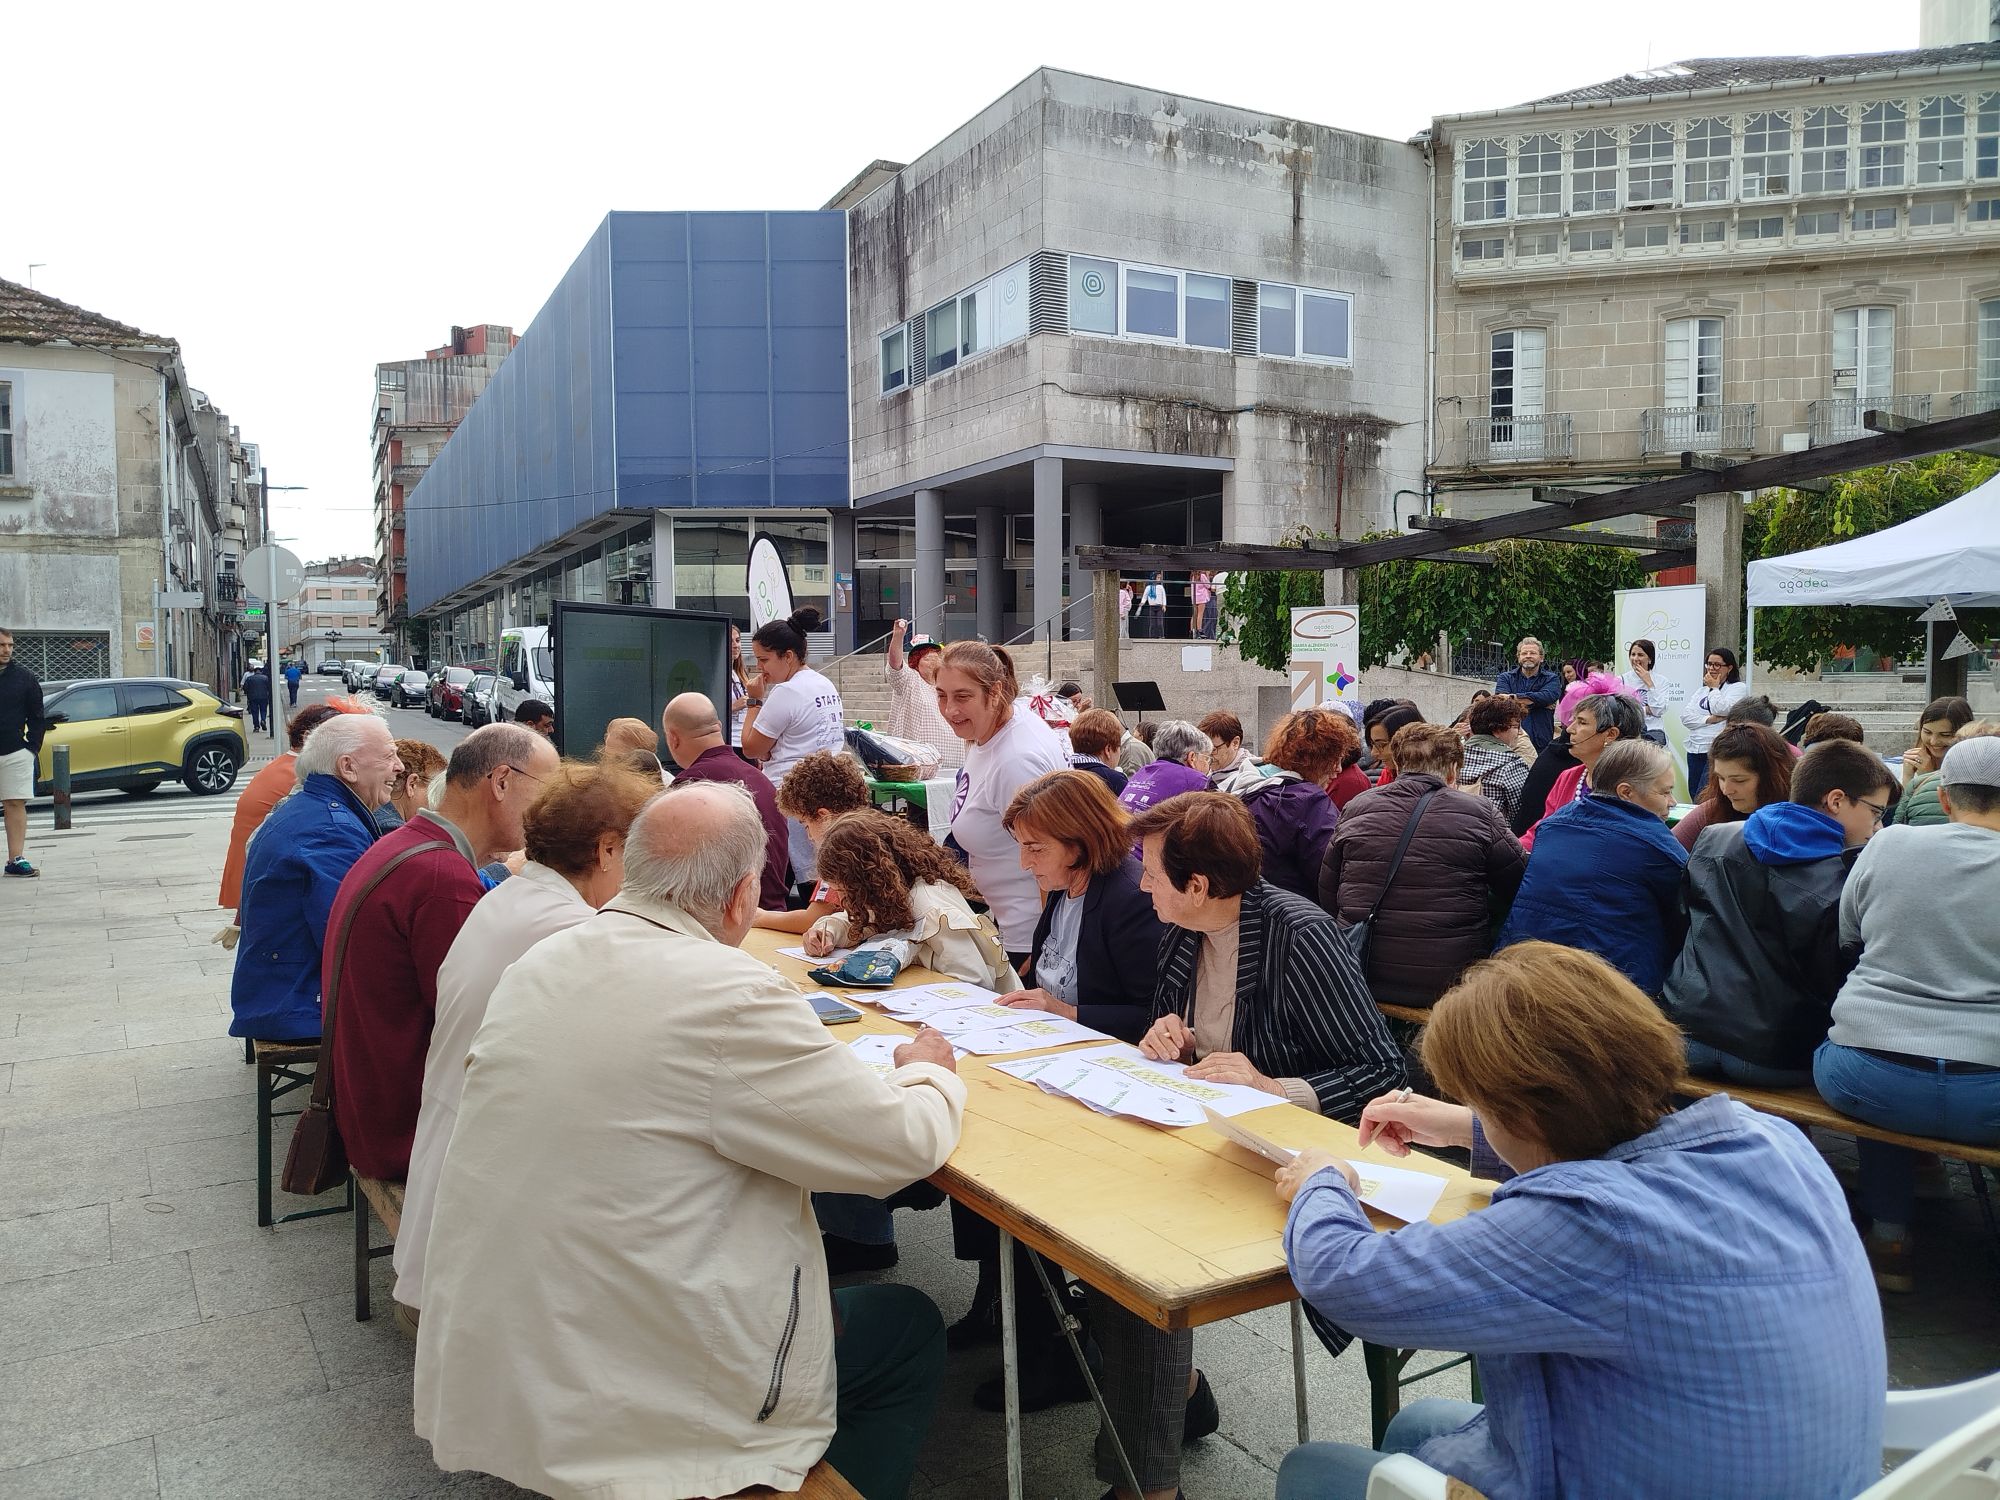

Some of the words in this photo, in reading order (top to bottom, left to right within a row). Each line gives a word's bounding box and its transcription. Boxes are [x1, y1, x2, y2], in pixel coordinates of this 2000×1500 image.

[1779, 577, 1829, 593] agadea
[1624, 634, 1691, 652] adea
[1957, 632, 1977, 651] BINGO
